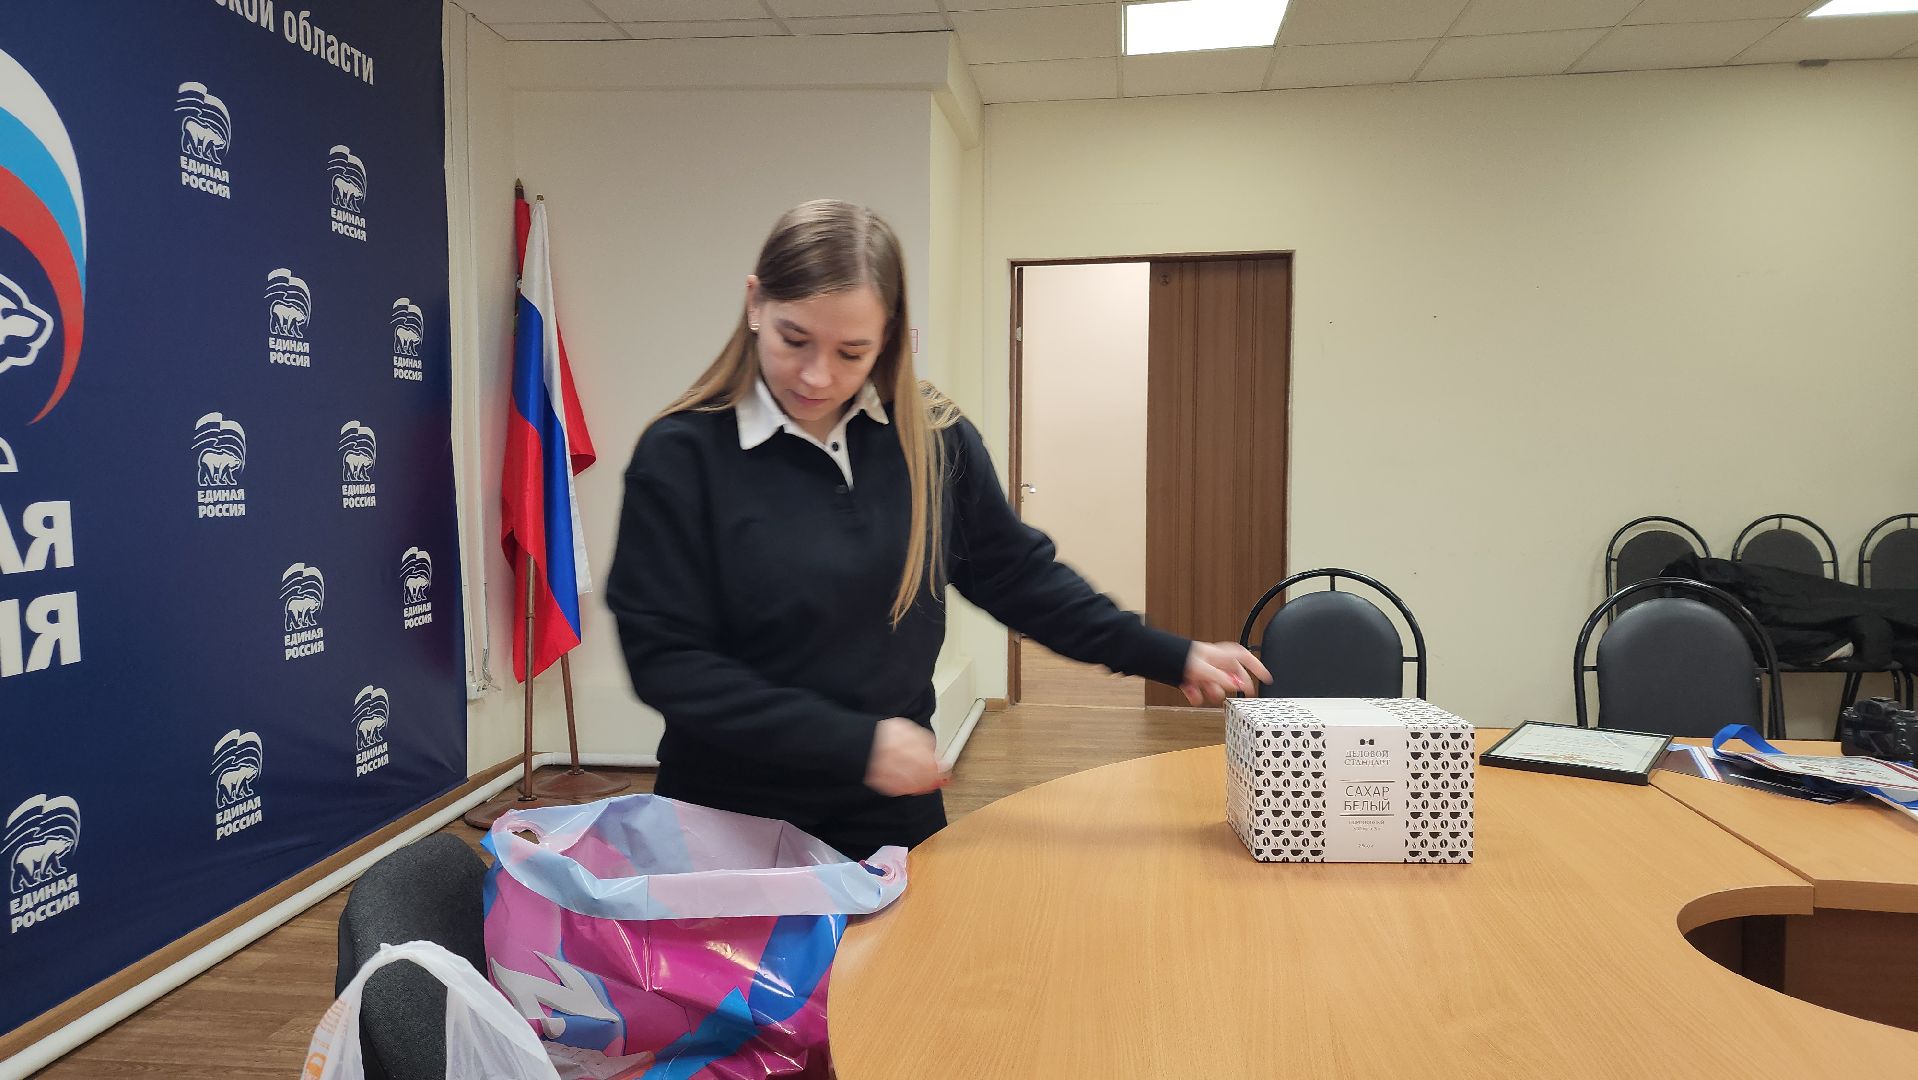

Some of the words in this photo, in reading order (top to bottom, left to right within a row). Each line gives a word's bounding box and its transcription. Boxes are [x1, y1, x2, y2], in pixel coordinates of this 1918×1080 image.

[283, 10, 374, 86] области
[180, 156, 230, 183] ЕДИНАЯ
[181, 172, 231, 200] РОССИЯ
[330, 208, 366, 228] ЕДИНАЯ
[331, 221, 367, 242] РОССИЯ
[268, 337, 310, 354] ЕДИНАЯ
[269, 351, 311, 367] РОССИЯ
[393, 356, 422, 370] ЕДИНАЯ
[393, 368, 423, 381] РОССИЯ
[197, 488, 245, 503] ЕДИНАЯ
[342, 483, 376, 496] ЕДИНАЯ
[342, 495, 376, 508] РОССИЯ
[198, 504, 246, 518] РОССИЯ
[403, 602, 432, 618] ЕДИНАЯ
[404, 613, 433, 630] РОССИЯ
[284, 627, 324, 647] ЕДИНАЯ
[285, 640, 325, 661] РОССИЯ
[355, 741, 388, 765] ЕДИНАЯ
[1345, 750, 1389, 758] ДЕЛОВОЙ
[356, 753, 389, 778] РОССИЯ
[1345, 785, 1390, 797] САХАР
[215, 796, 261, 826] ЕДИНАЯ
[1344, 798, 1391, 812] БЕЛЫЙ
[216, 809, 263, 841] РОССИЯ
[9, 873, 78, 915] ЕДИНАЯ
[11, 891, 80, 934] РОССИЯ
